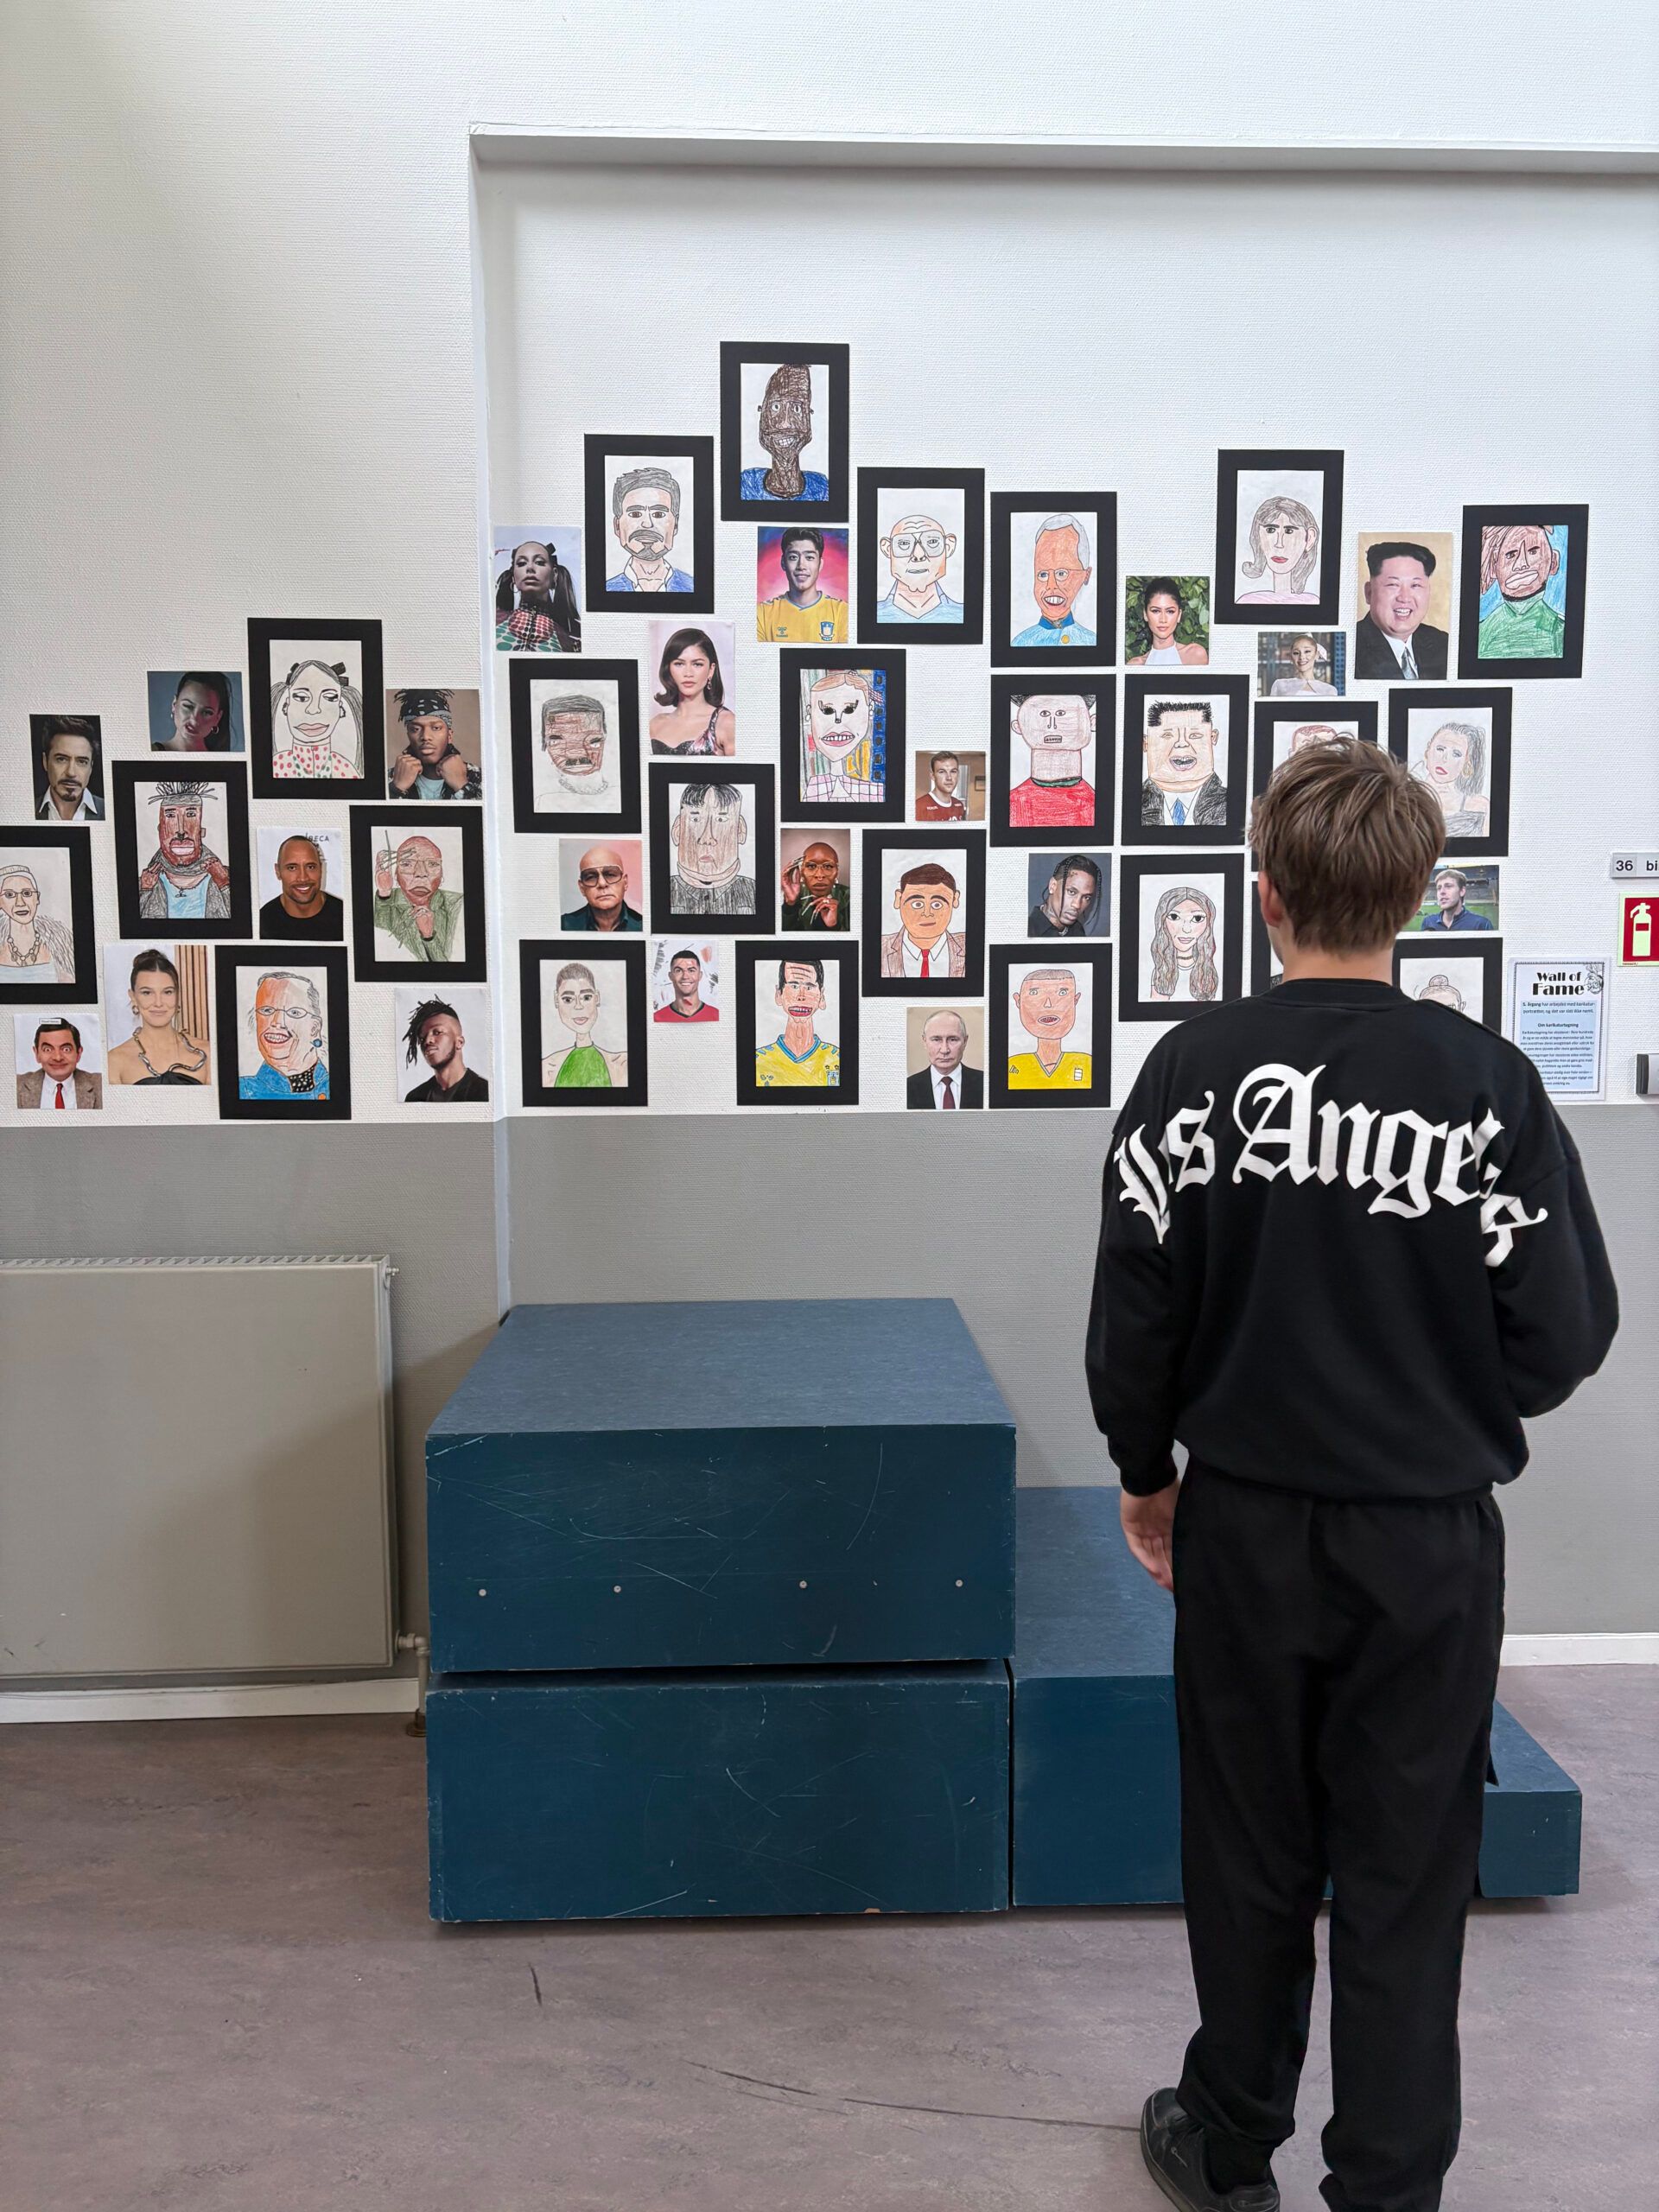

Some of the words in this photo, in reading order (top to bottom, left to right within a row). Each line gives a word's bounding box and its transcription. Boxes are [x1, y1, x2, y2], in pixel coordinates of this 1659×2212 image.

[1616, 860, 1634, 872] 36
[1646, 860, 1659, 872] bi
[1536, 972, 1566, 982] Wall
[1568, 971, 1582, 982] of
[1532, 982, 1585, 995] Fame
[1113, 1090, 1216, 1245] Ls
